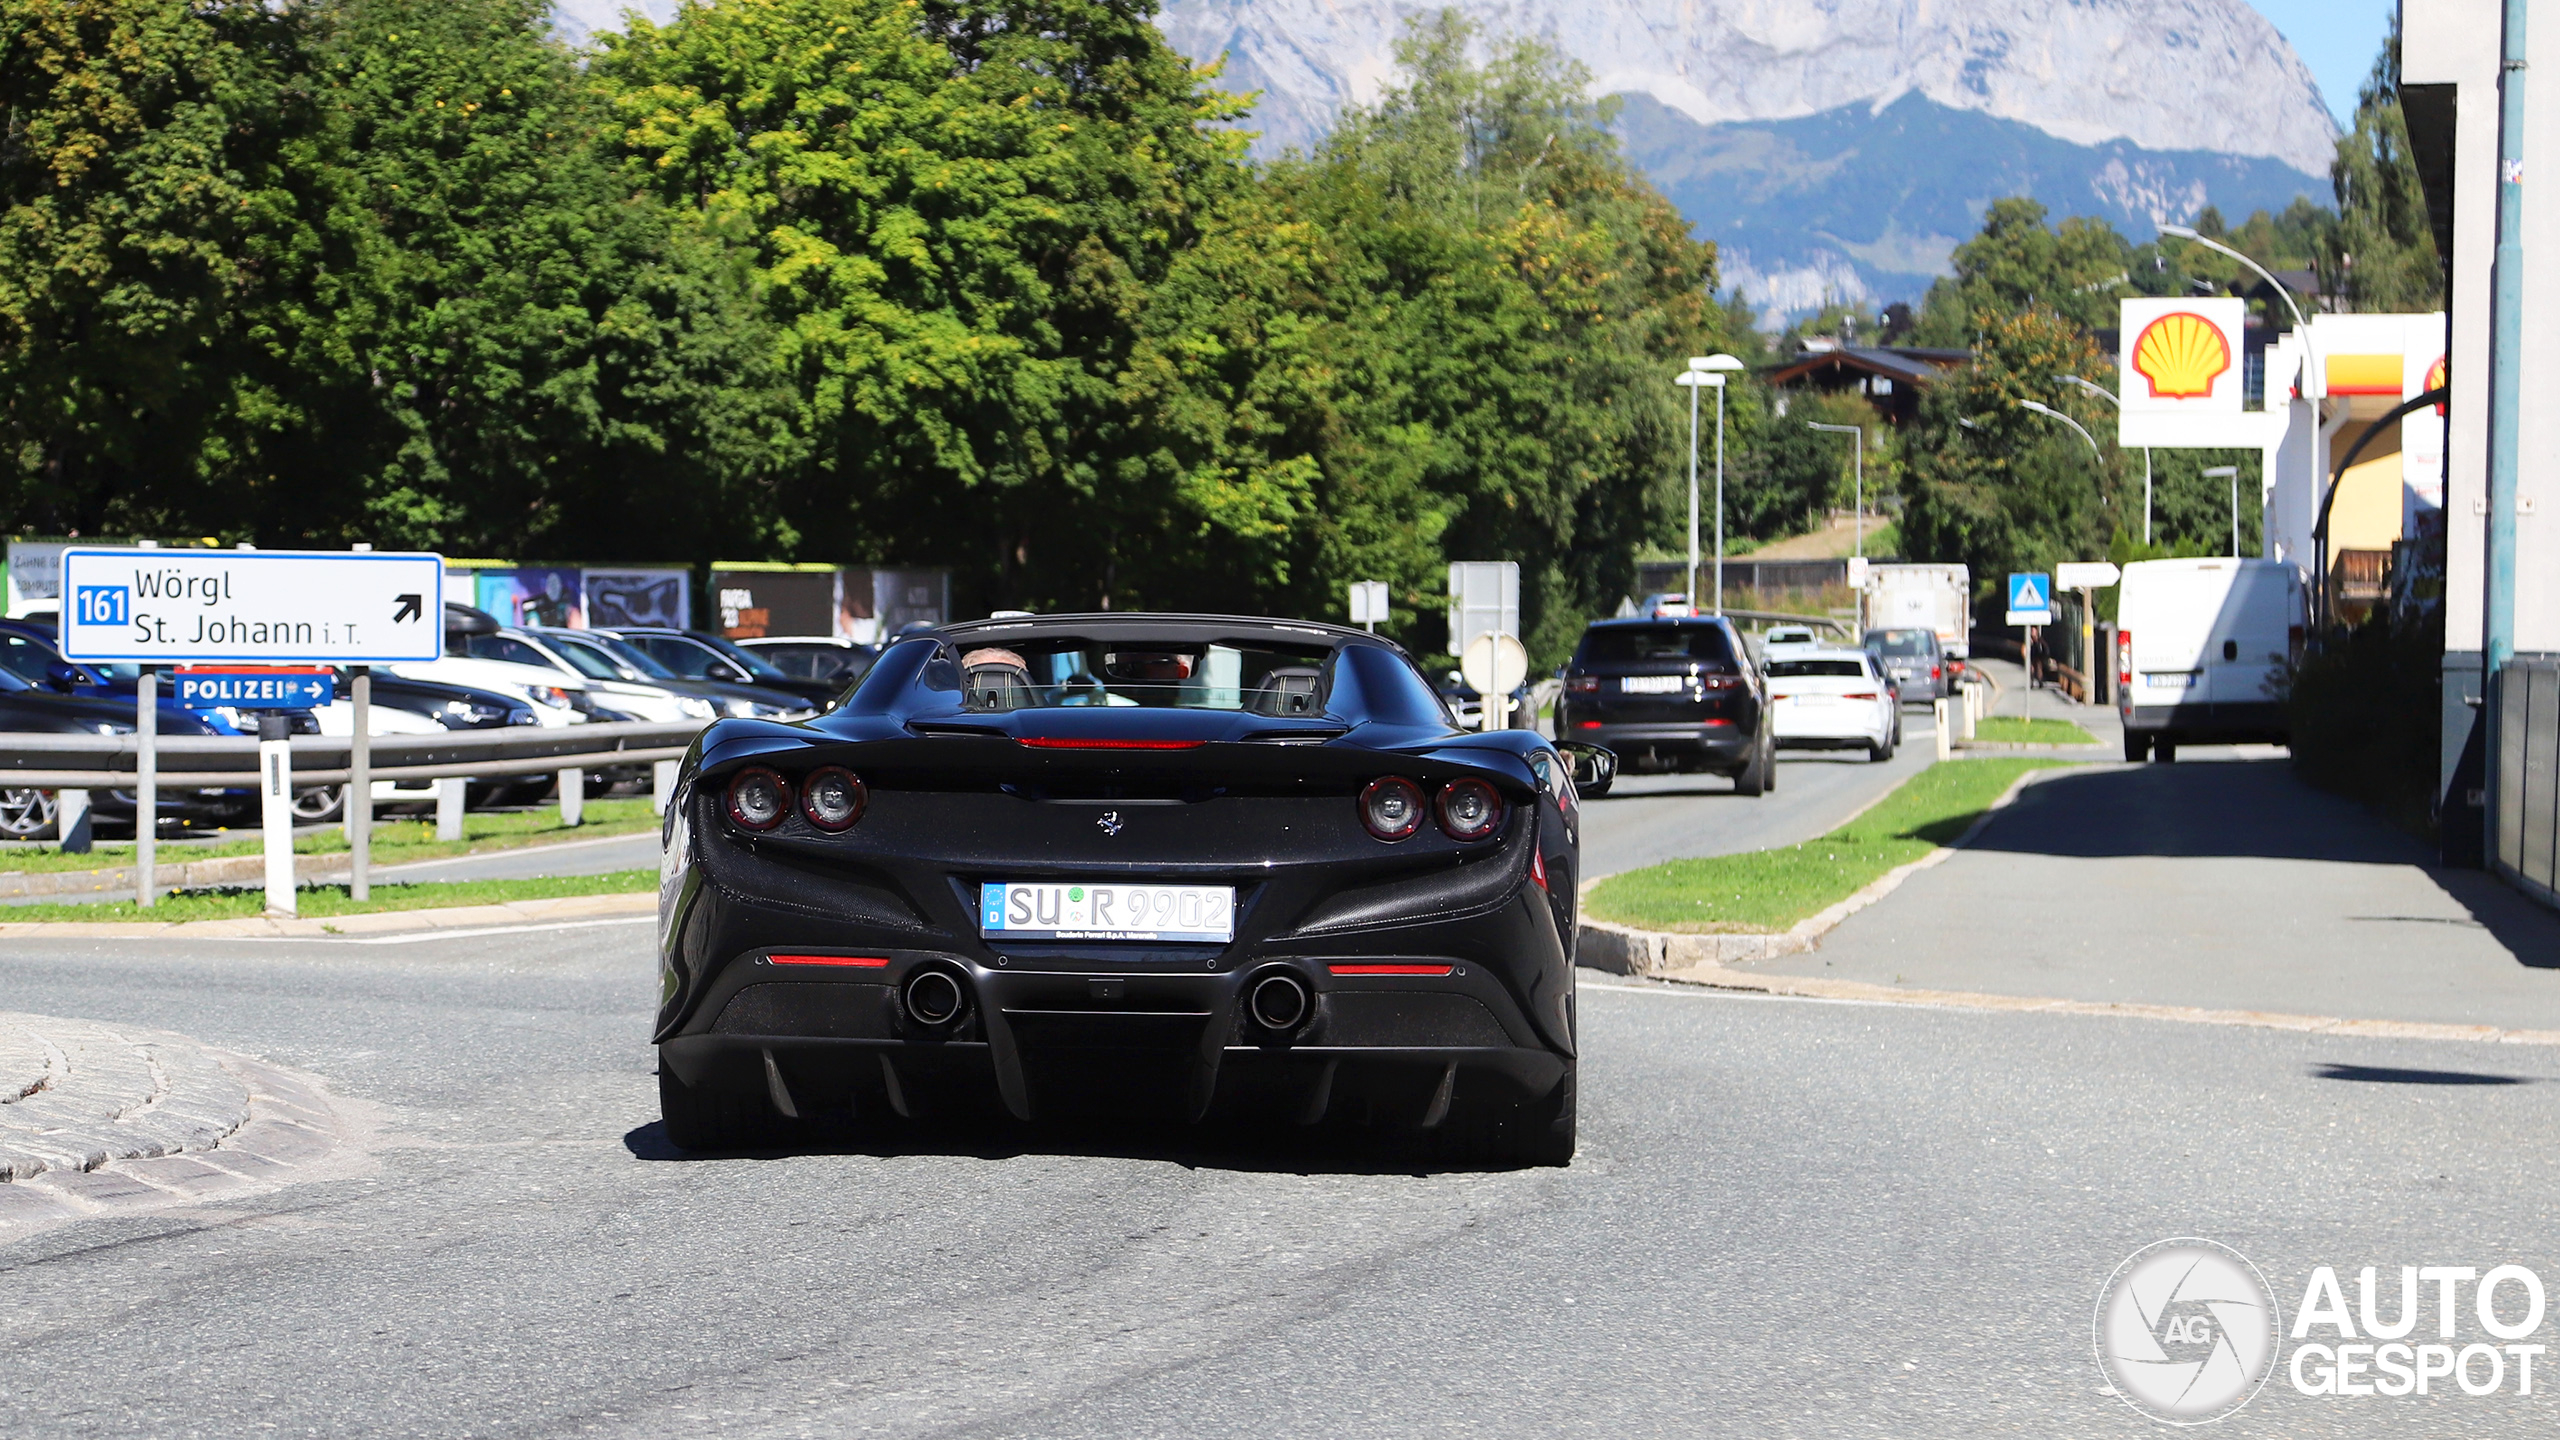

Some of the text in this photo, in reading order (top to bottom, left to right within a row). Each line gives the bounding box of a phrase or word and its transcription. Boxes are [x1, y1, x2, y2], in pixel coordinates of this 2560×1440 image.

[134, 569, 232, 606] Wörgl
[79, 590, 125, 623] 161
[134, 614, 361, 646] St. Johann i. T.
[183, 680, 284, 700] POLIZEI
[989, 910, 1000, 923] D
[1008, 887, 1228, 928] SU R 9902
[1084, 931, 1105, 939] Ferrari
